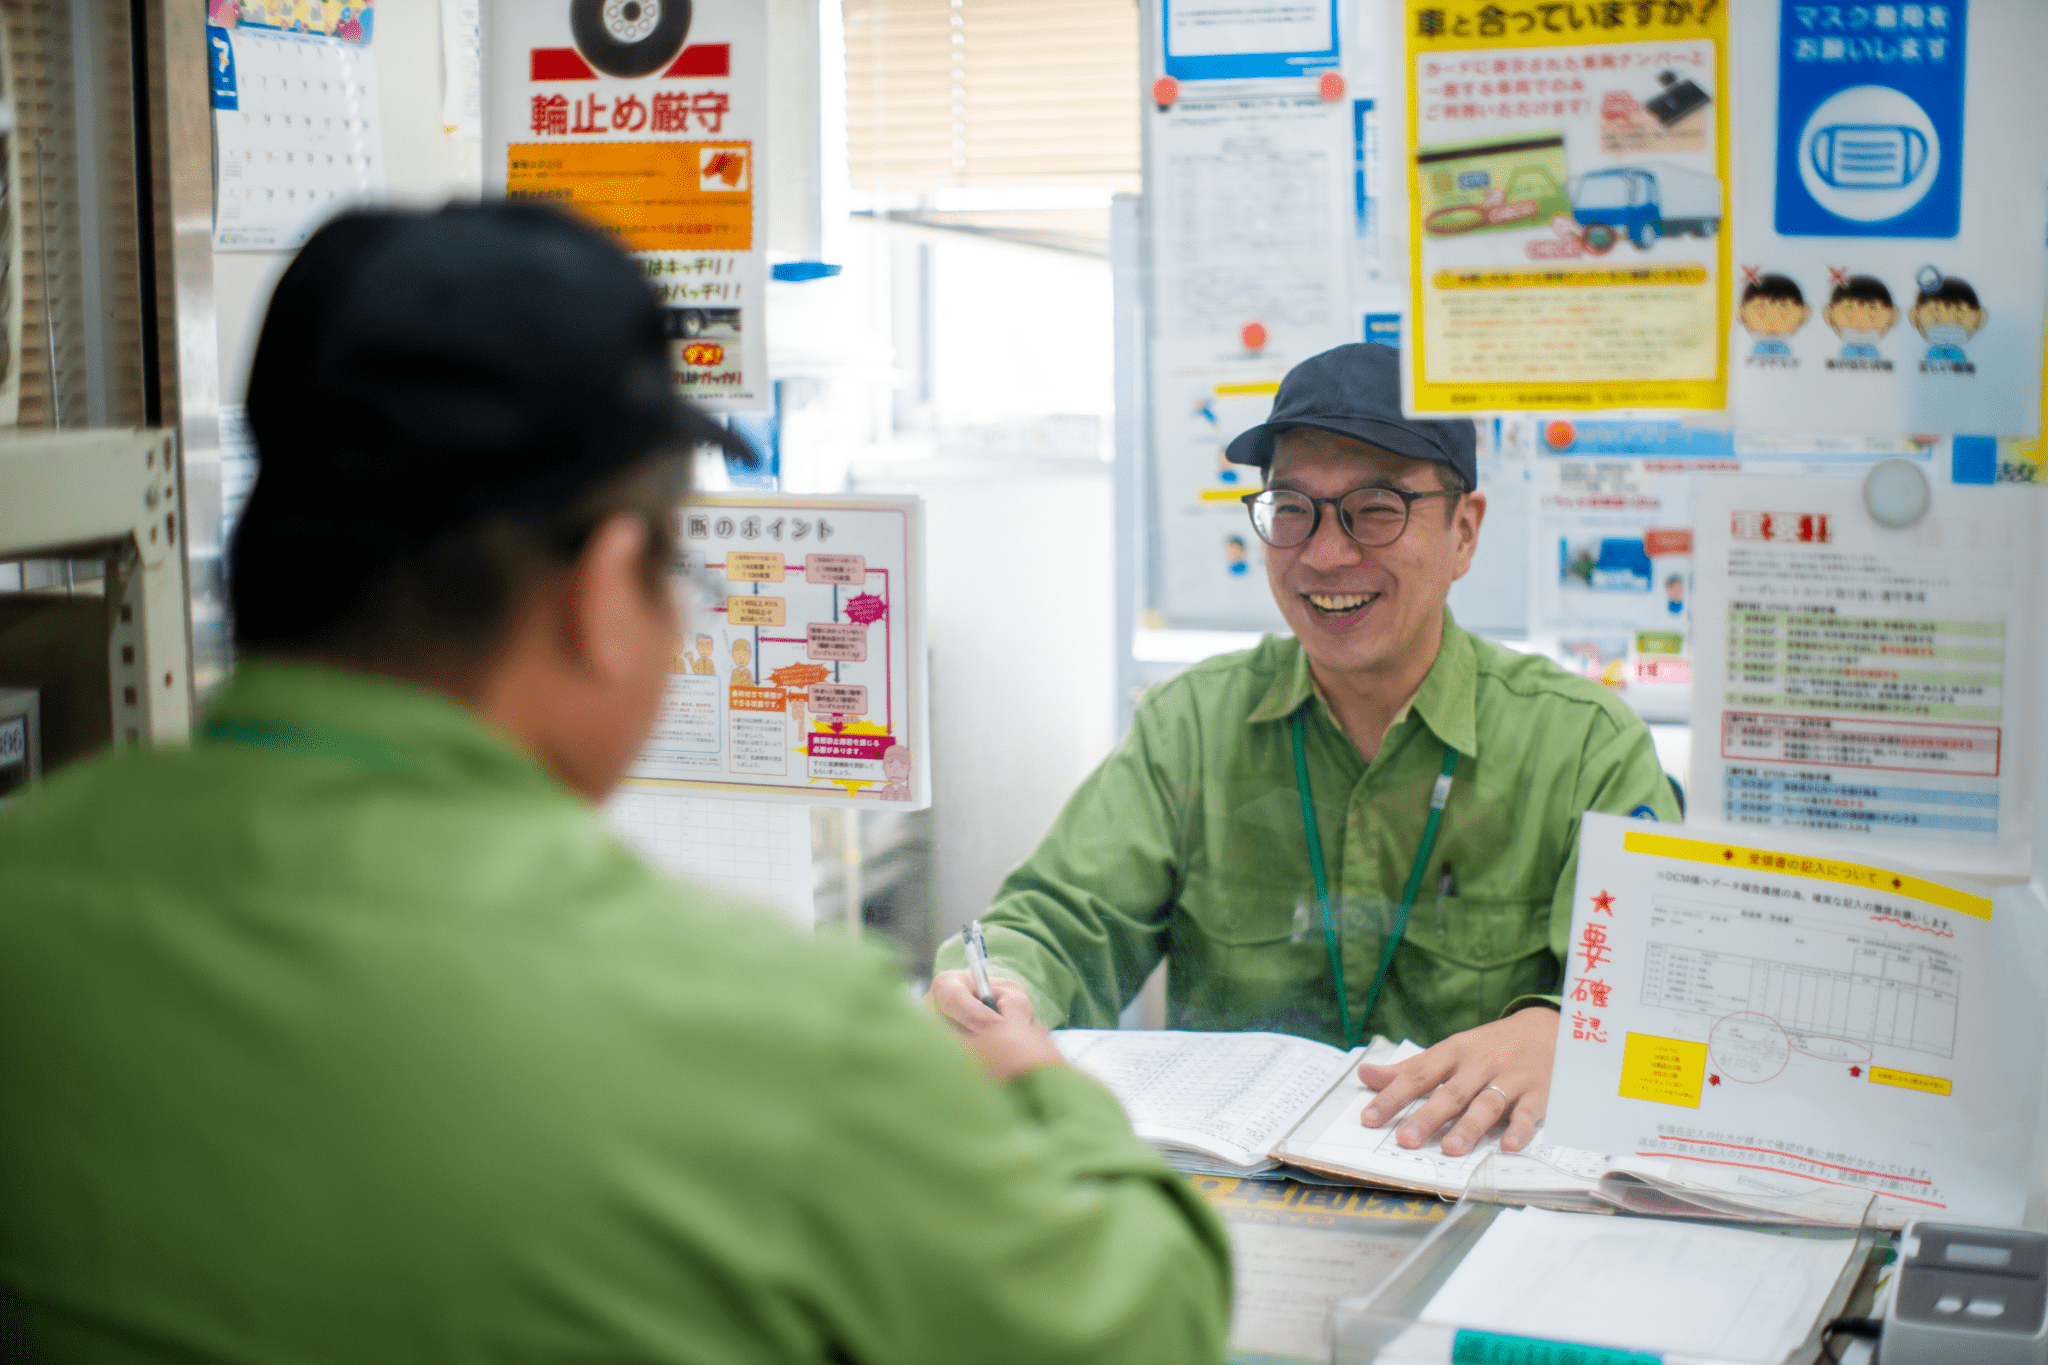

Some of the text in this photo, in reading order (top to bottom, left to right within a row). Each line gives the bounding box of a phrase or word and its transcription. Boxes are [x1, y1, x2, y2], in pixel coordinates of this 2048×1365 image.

[1793, 36, 1950, 63] お願いします
[529, 91, 730, 136] 輪止め厳守
